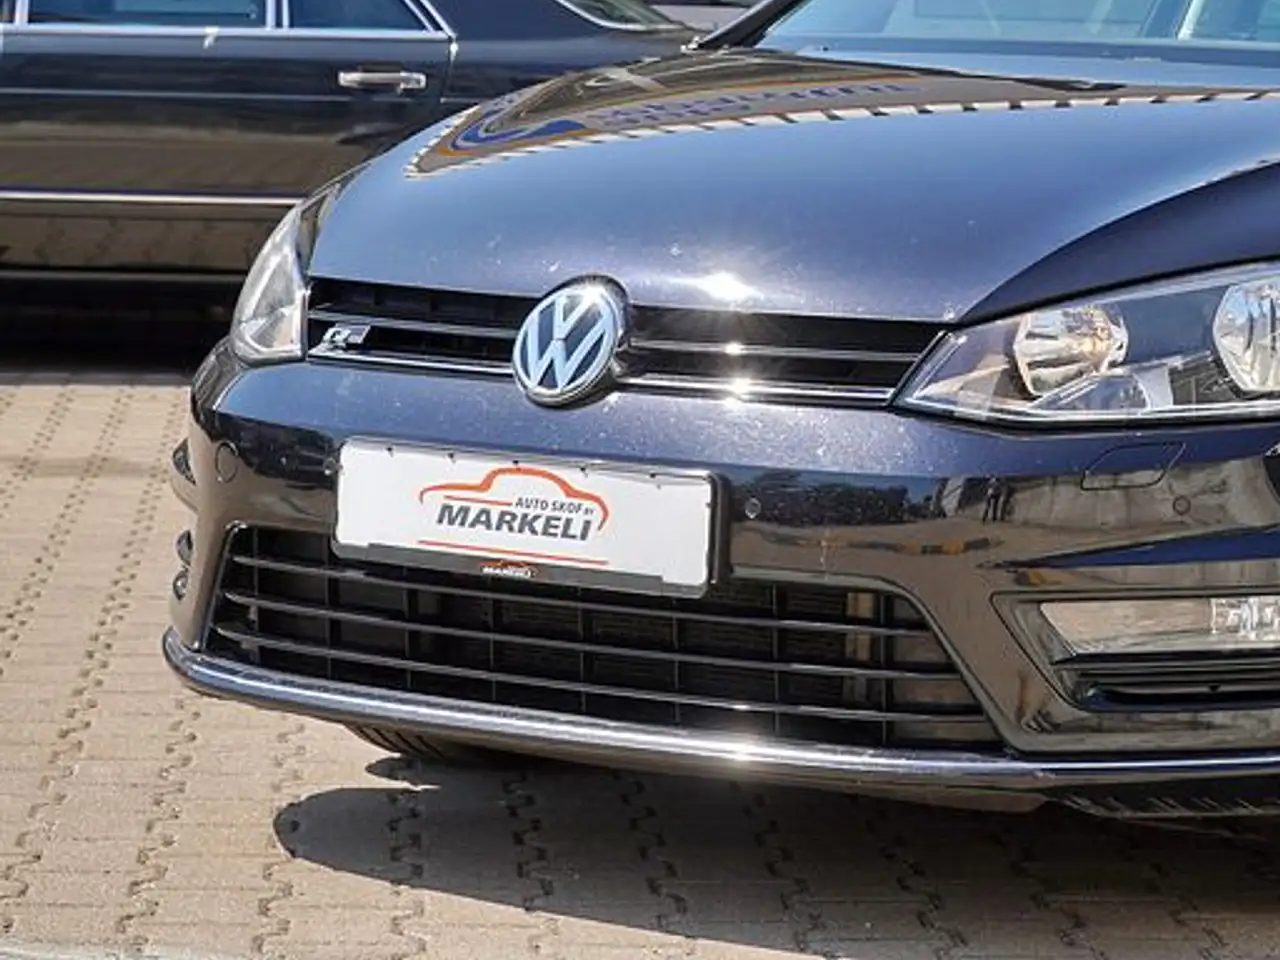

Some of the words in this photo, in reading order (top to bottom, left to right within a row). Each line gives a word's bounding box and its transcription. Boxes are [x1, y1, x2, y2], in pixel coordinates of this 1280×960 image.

[514, 496, 549, 512] AUTO
[550, 500, 583, 515] SKOF
[436, 503, 592, 541] MARKELI
